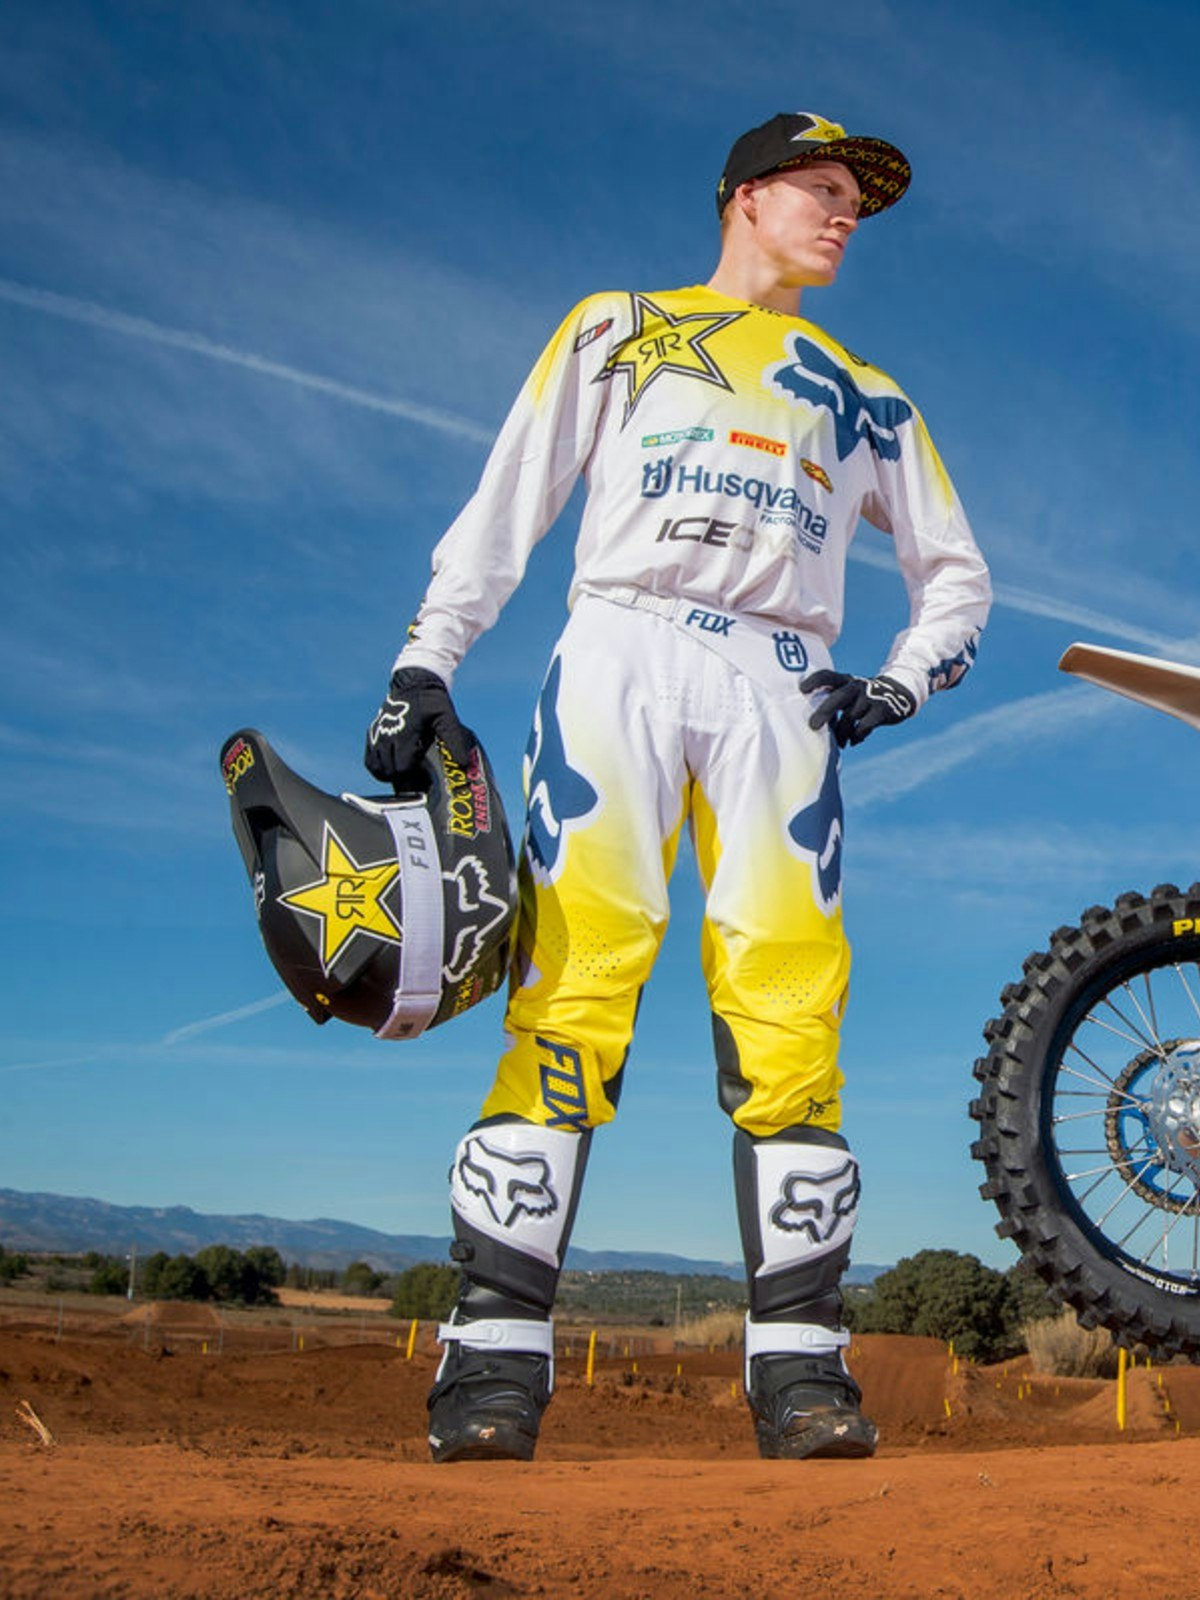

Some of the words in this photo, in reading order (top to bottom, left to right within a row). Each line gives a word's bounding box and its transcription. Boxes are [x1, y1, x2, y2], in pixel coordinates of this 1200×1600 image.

[685, 609, 737, 637] FOX
[402, 818, 431, 869] FOX
[535, 1036, 591, 1132] FOX
